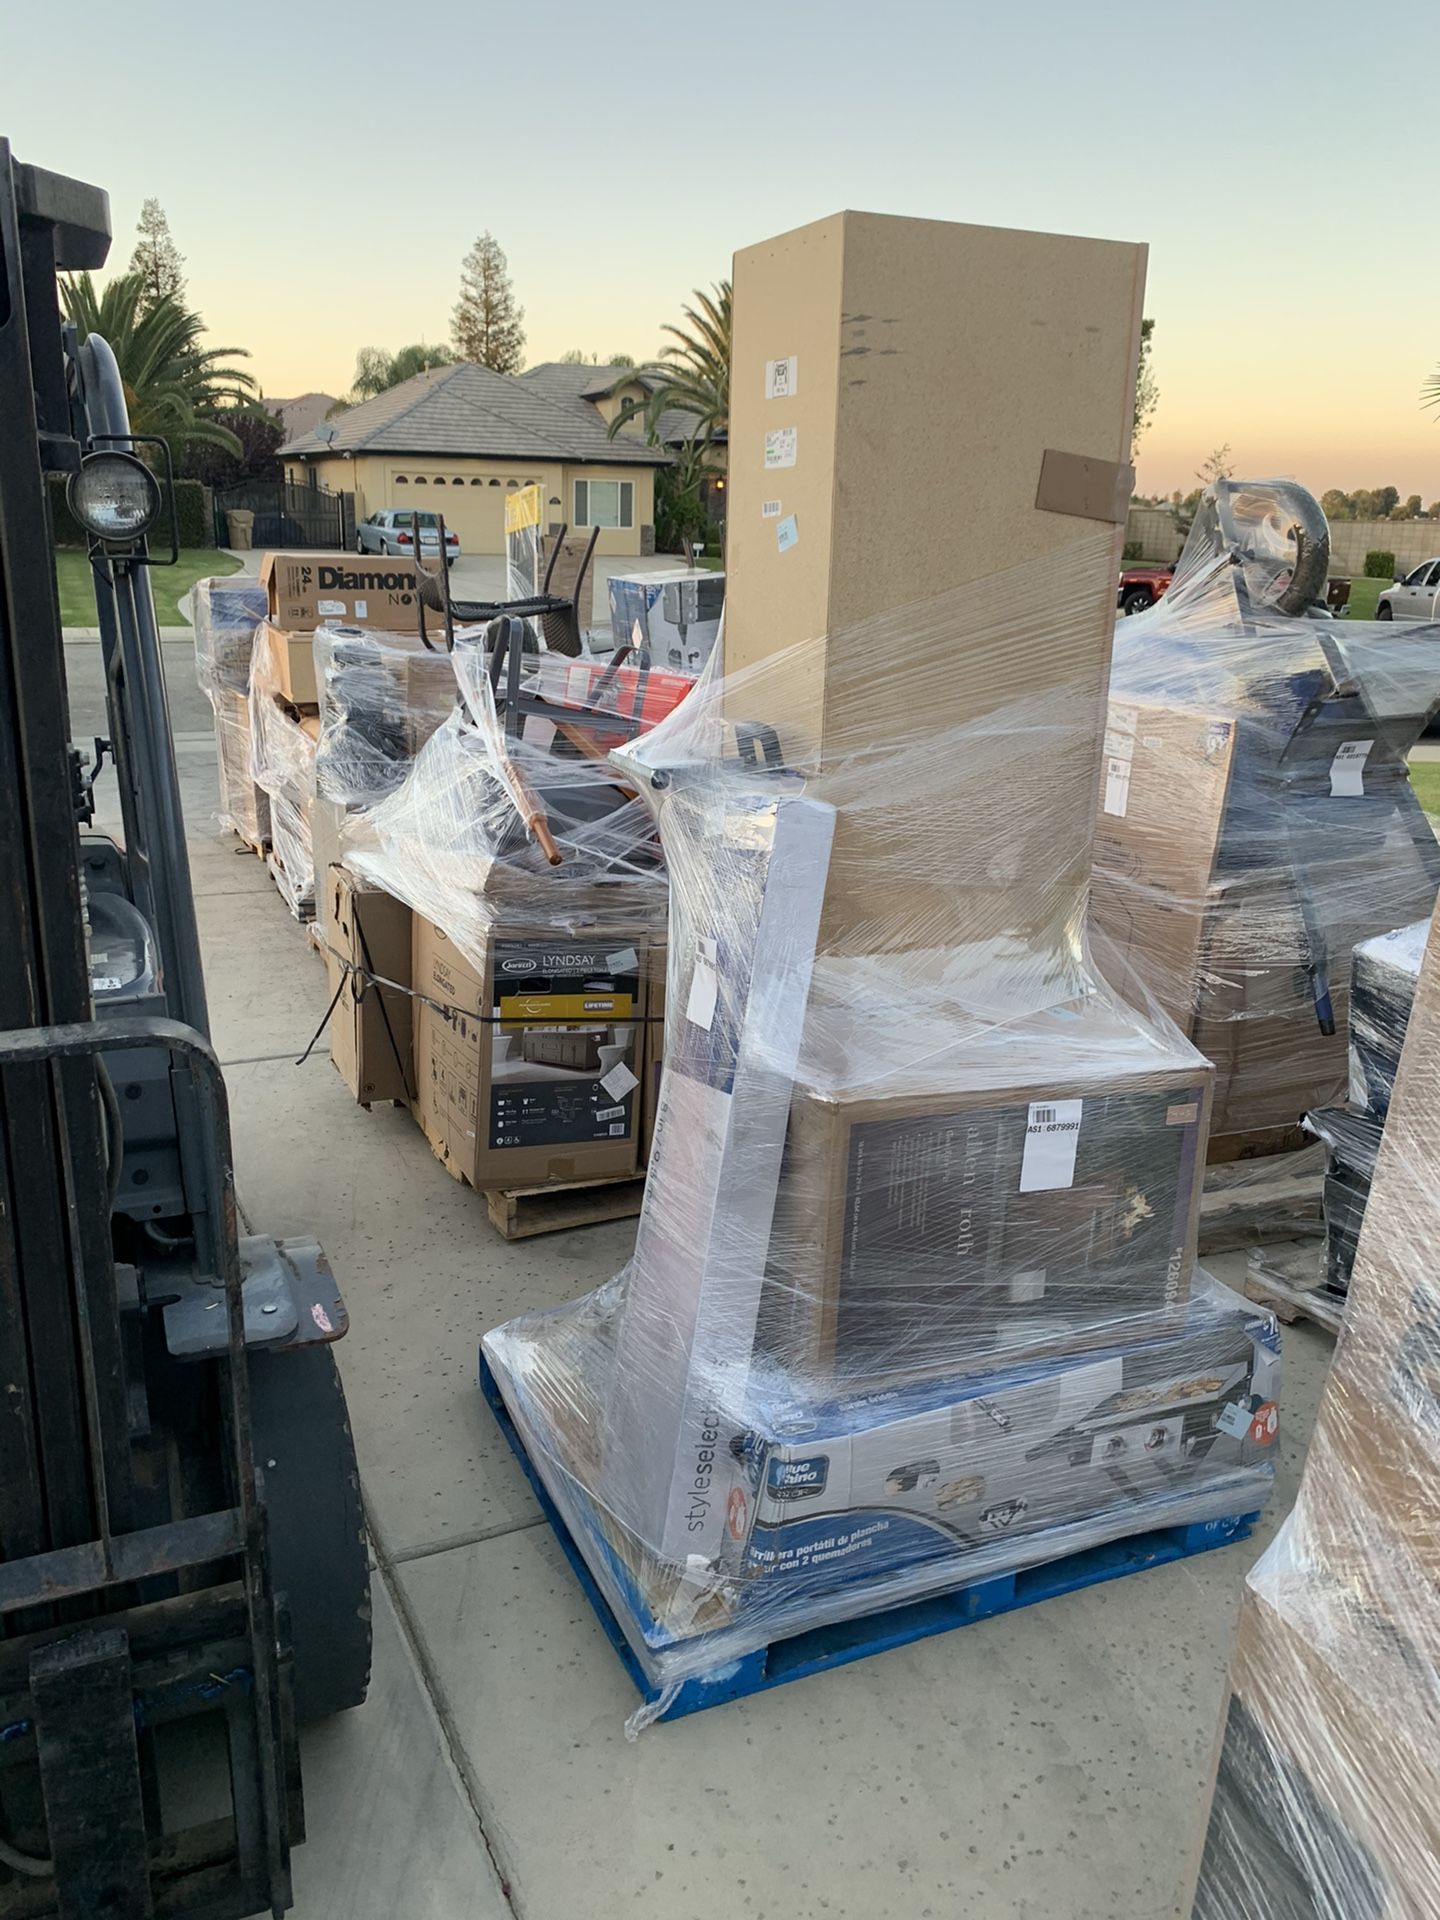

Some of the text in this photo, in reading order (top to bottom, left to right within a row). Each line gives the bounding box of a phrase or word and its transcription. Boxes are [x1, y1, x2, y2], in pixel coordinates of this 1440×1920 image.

[301, 566, 312, 584] 24
[542, 954, 596, 967] LYNDSAY
[584, 1001, 614, 1010] LIFETIME
[1046, 1122, 1079, 1132] 6879991
[956, 1208, 975, 1256] roth
[796, 1540, 834, 1558] portátil
[851, 1520, 889, 1544] plancha
[779, 1560, 799, 1571] con
[802, 1556, 809, 1566] 2
